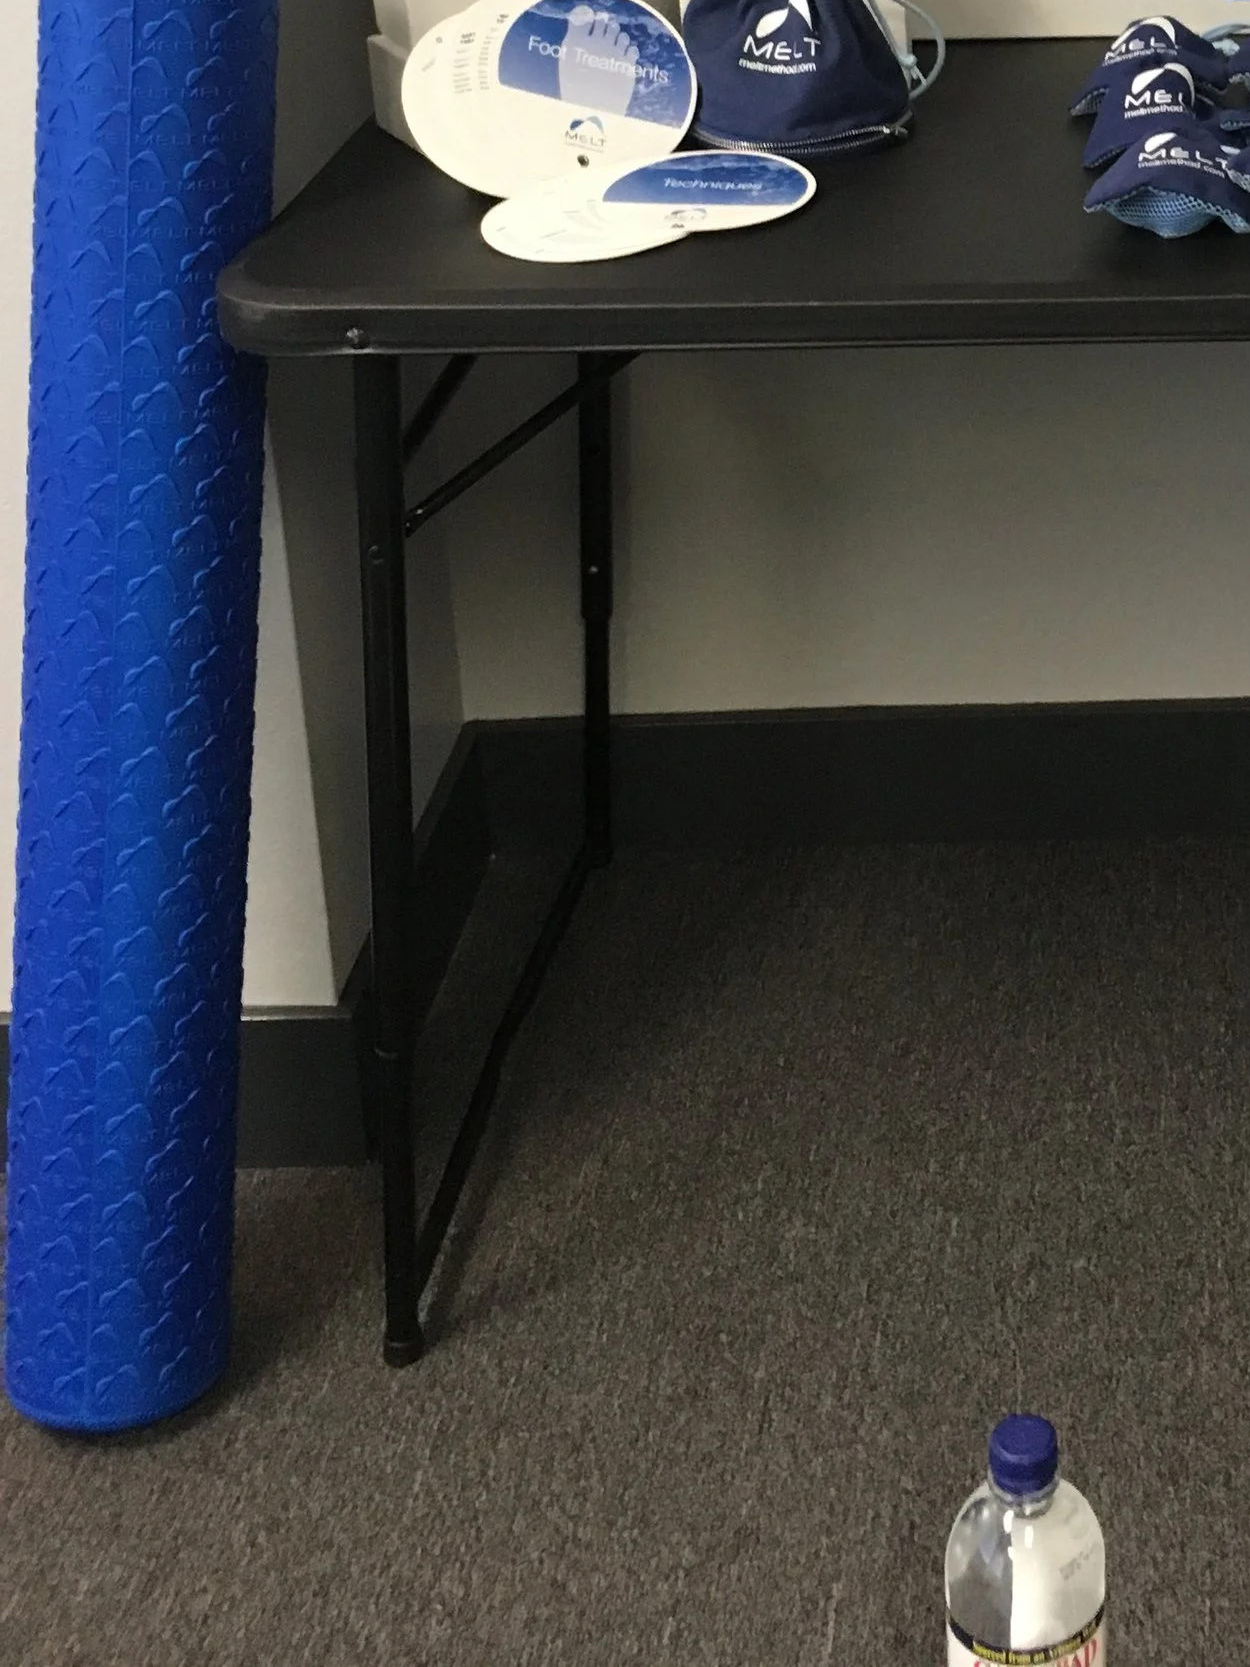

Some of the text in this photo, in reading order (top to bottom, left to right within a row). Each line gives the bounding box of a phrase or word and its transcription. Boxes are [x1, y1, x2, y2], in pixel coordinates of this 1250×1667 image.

[528, 35, 568, 61] Foot
[744, 34, 821, 61] MELT
[1104, 36, 1167, 62] MEL
[574, 47, 670, 84] Treatments
[1124, 89, 1186, 110] MEL
[1124, 104, 1184, 120] meltmethod
[564, 130, 606, 148] MELT
[1138, 146, 1229, 171] MELT
[664, 177, 763, 191] Techniques
